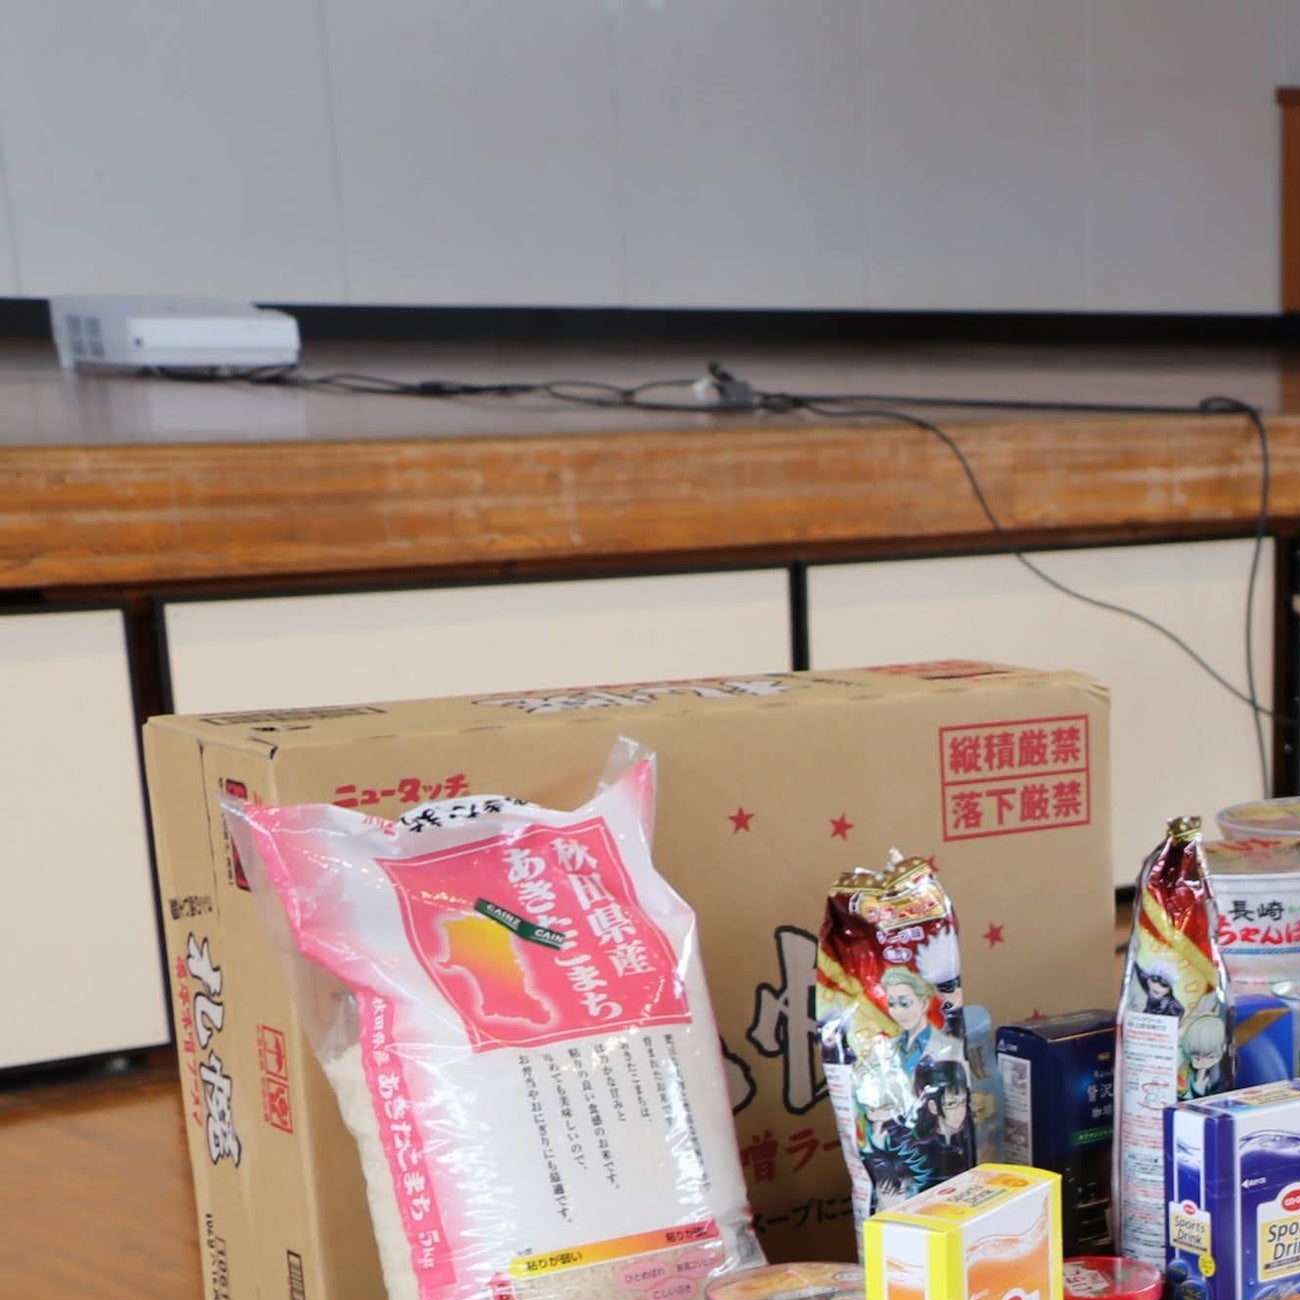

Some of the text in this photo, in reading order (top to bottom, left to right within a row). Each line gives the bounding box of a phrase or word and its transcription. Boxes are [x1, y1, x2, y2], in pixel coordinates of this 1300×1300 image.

[949, 727, 1082, 776] 縦積厳禁
[332, 774, 470, 807] ニュータッチ
[951, 780, 1083, 831] 落下厳禁
[1228, 899, 1285, 922] 長崎
[1174, 1214, 1206, 1233] Sports
[1176, 1228, 1203, 1244] Drink
